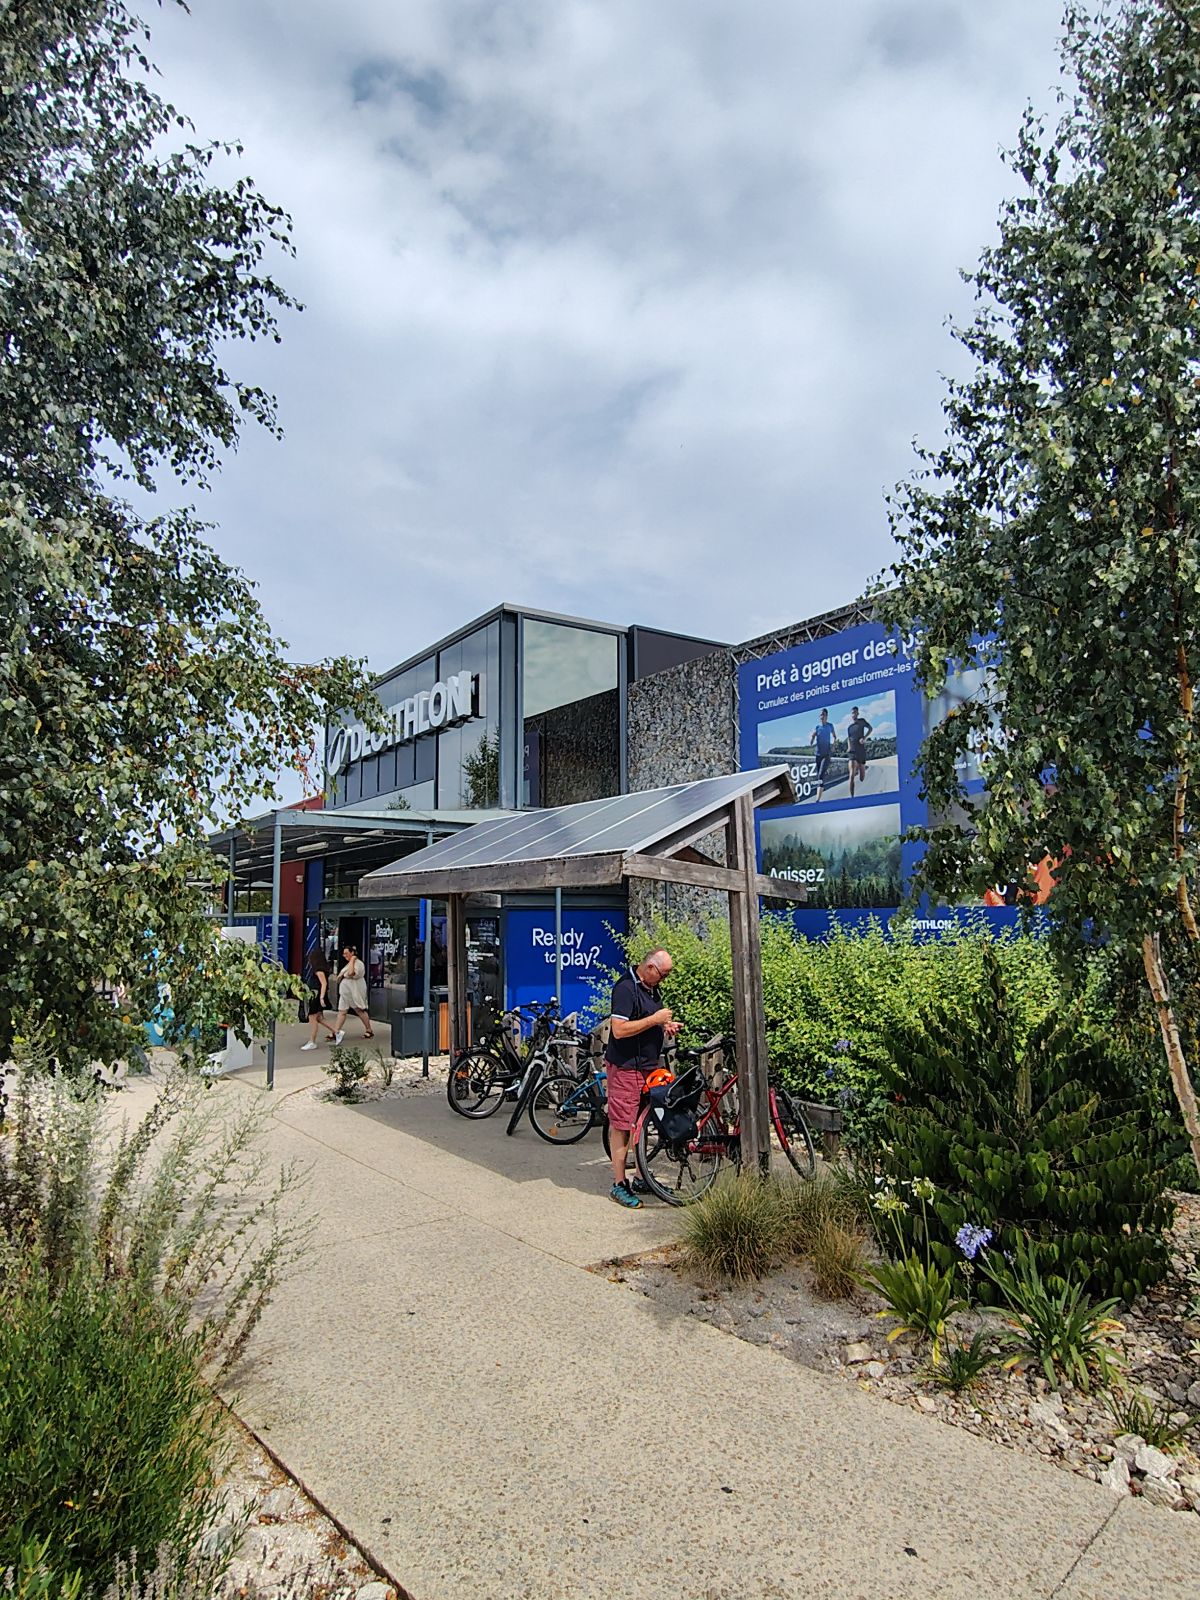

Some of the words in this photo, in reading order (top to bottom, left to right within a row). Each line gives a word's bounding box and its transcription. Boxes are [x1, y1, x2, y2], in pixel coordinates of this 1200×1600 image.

[757, 668, 786, 692] Prêt
[790, 664, 799, 683] à
[802, 648, 859, 682] gagner
[863, 638, 896, 660] des
[758, 696, 789, 711] Cumulez
[790, 691, 805, 702] des
[805, 683, 830, 700] points
[831, 680, 840, 691] et
[841, 662, 911, 688] transformez-les
[795, 782, 811, 797] 00
[532, 927, 584, 950] Ready
